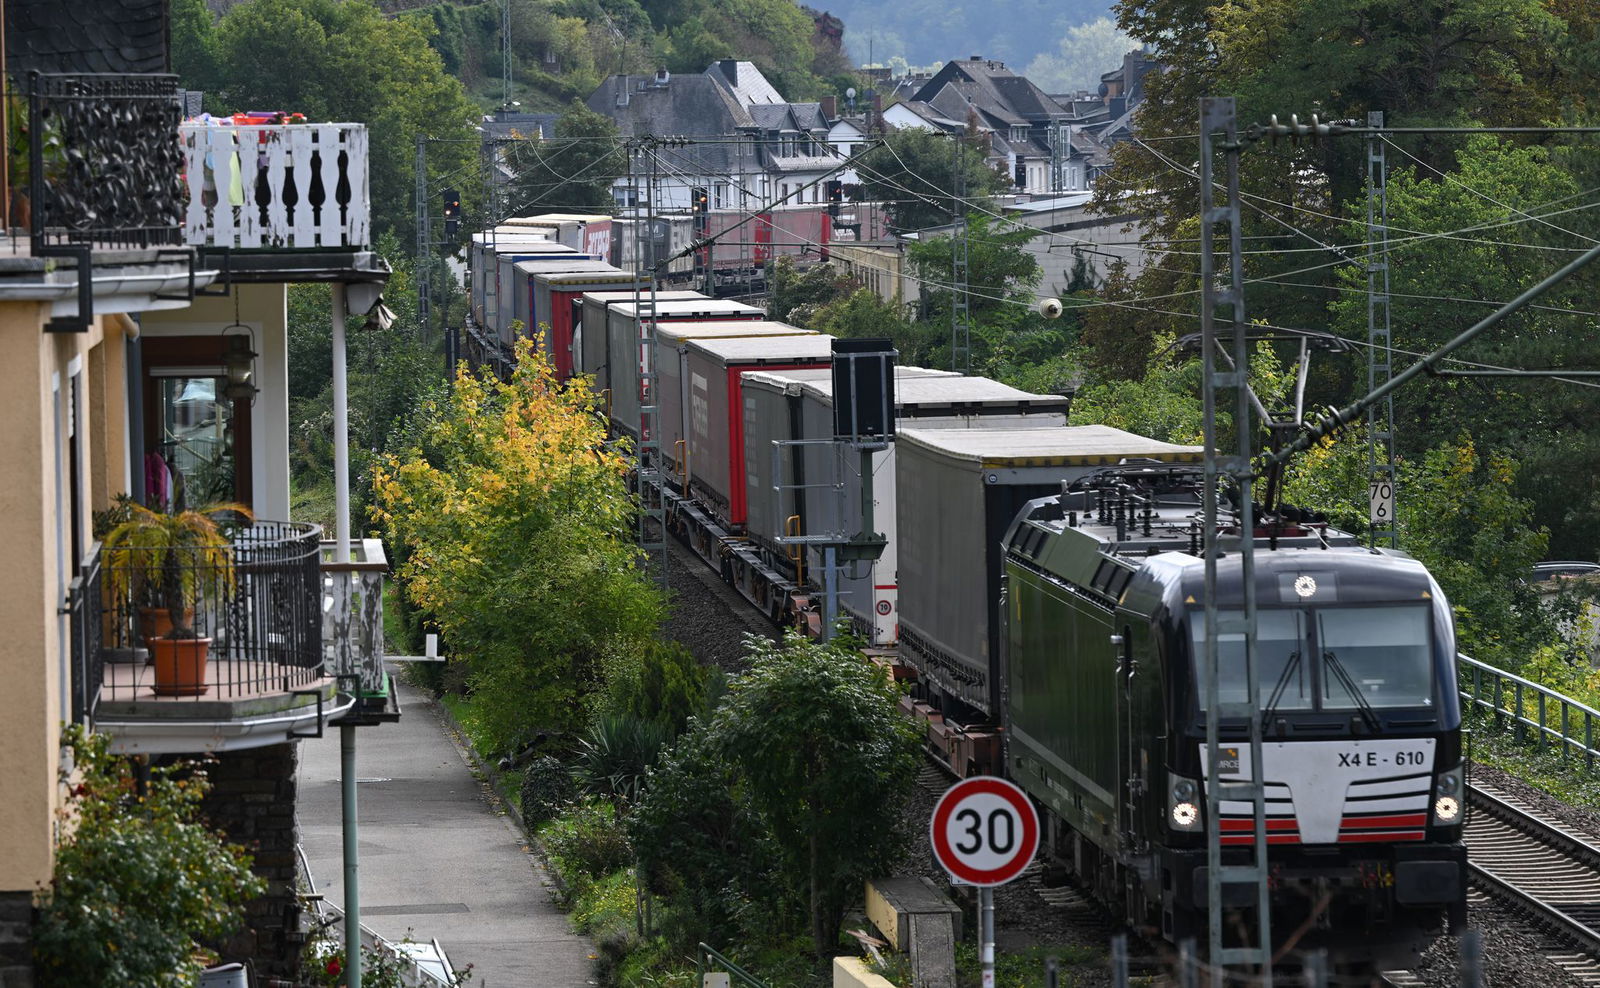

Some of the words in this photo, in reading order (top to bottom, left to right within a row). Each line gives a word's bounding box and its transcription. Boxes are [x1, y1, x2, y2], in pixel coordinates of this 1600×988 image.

[1370, 484, 1391, 500] 70
[1376, 502, 1387, 518] 6
[1395, 751, 1424, 766] 610
[955, 808, 1014, 855] 30
